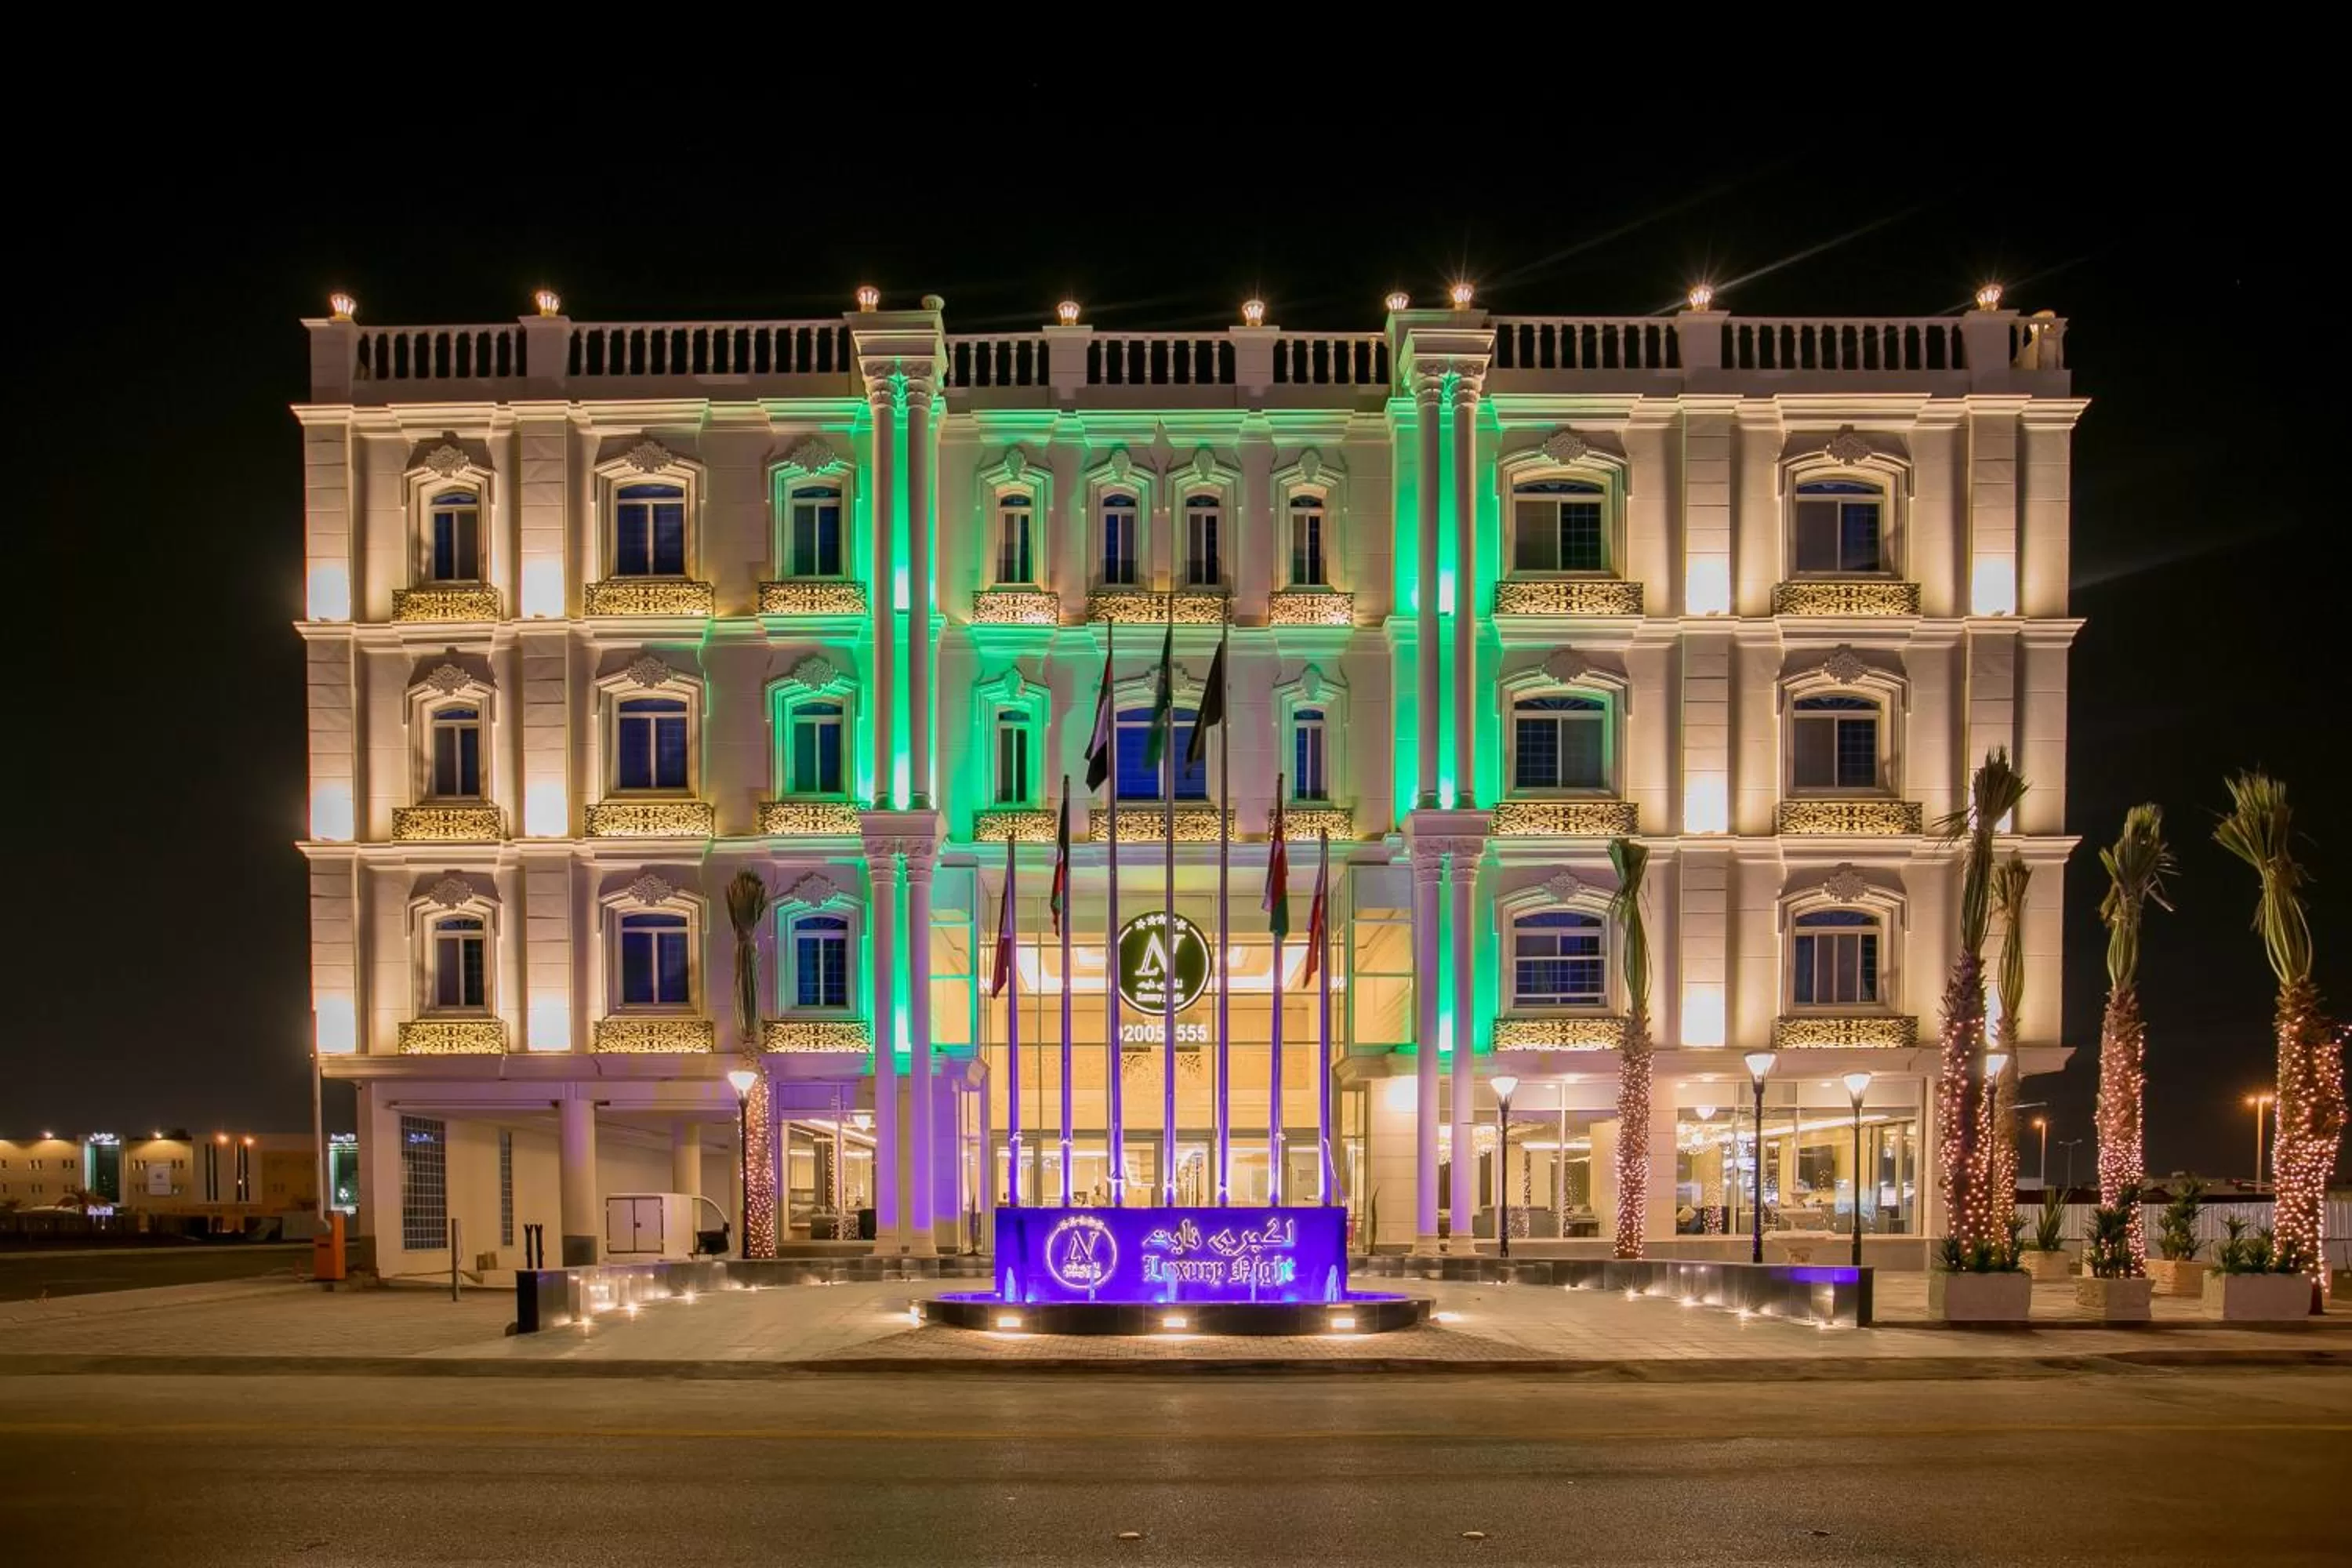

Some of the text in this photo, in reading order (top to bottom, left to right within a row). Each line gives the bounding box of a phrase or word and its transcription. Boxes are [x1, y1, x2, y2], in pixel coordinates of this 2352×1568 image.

[1119, 1024, 1207, 1042] 2005555
[1142, 1218, 1203, 1255] نايت
[1142, 1254, 1297, 1287] Luxury Night
